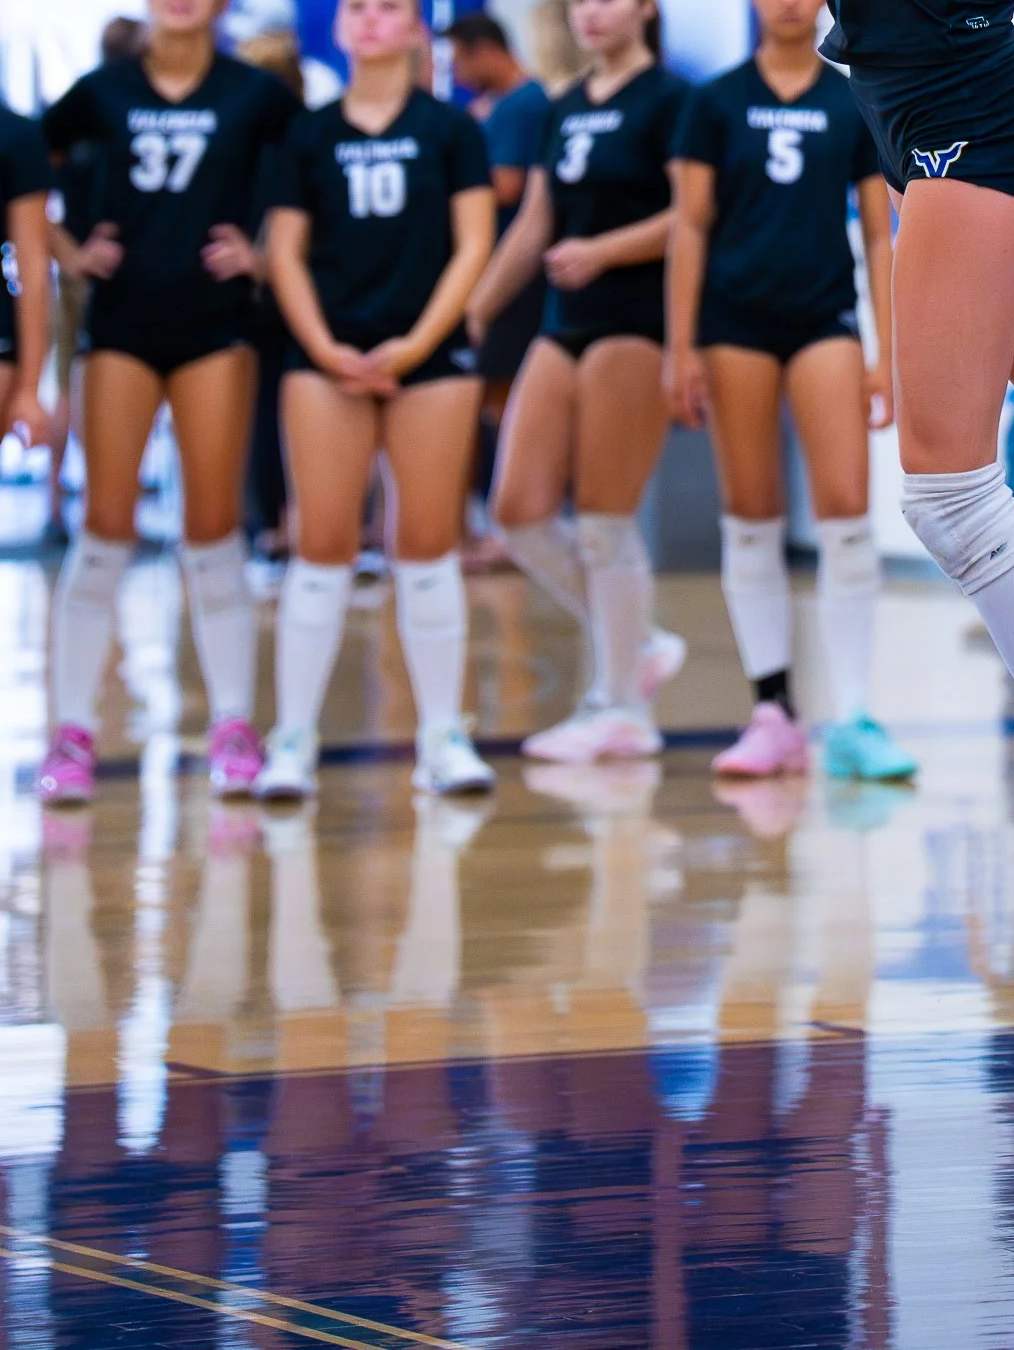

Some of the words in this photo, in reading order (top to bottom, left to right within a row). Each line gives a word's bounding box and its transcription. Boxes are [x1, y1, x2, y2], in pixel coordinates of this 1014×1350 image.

[130, 134, 206, 192] 37
[557, 135, 593, 183] 3
[766, 130, 804, 183] 5
[344, 163, 405, 217] 10
